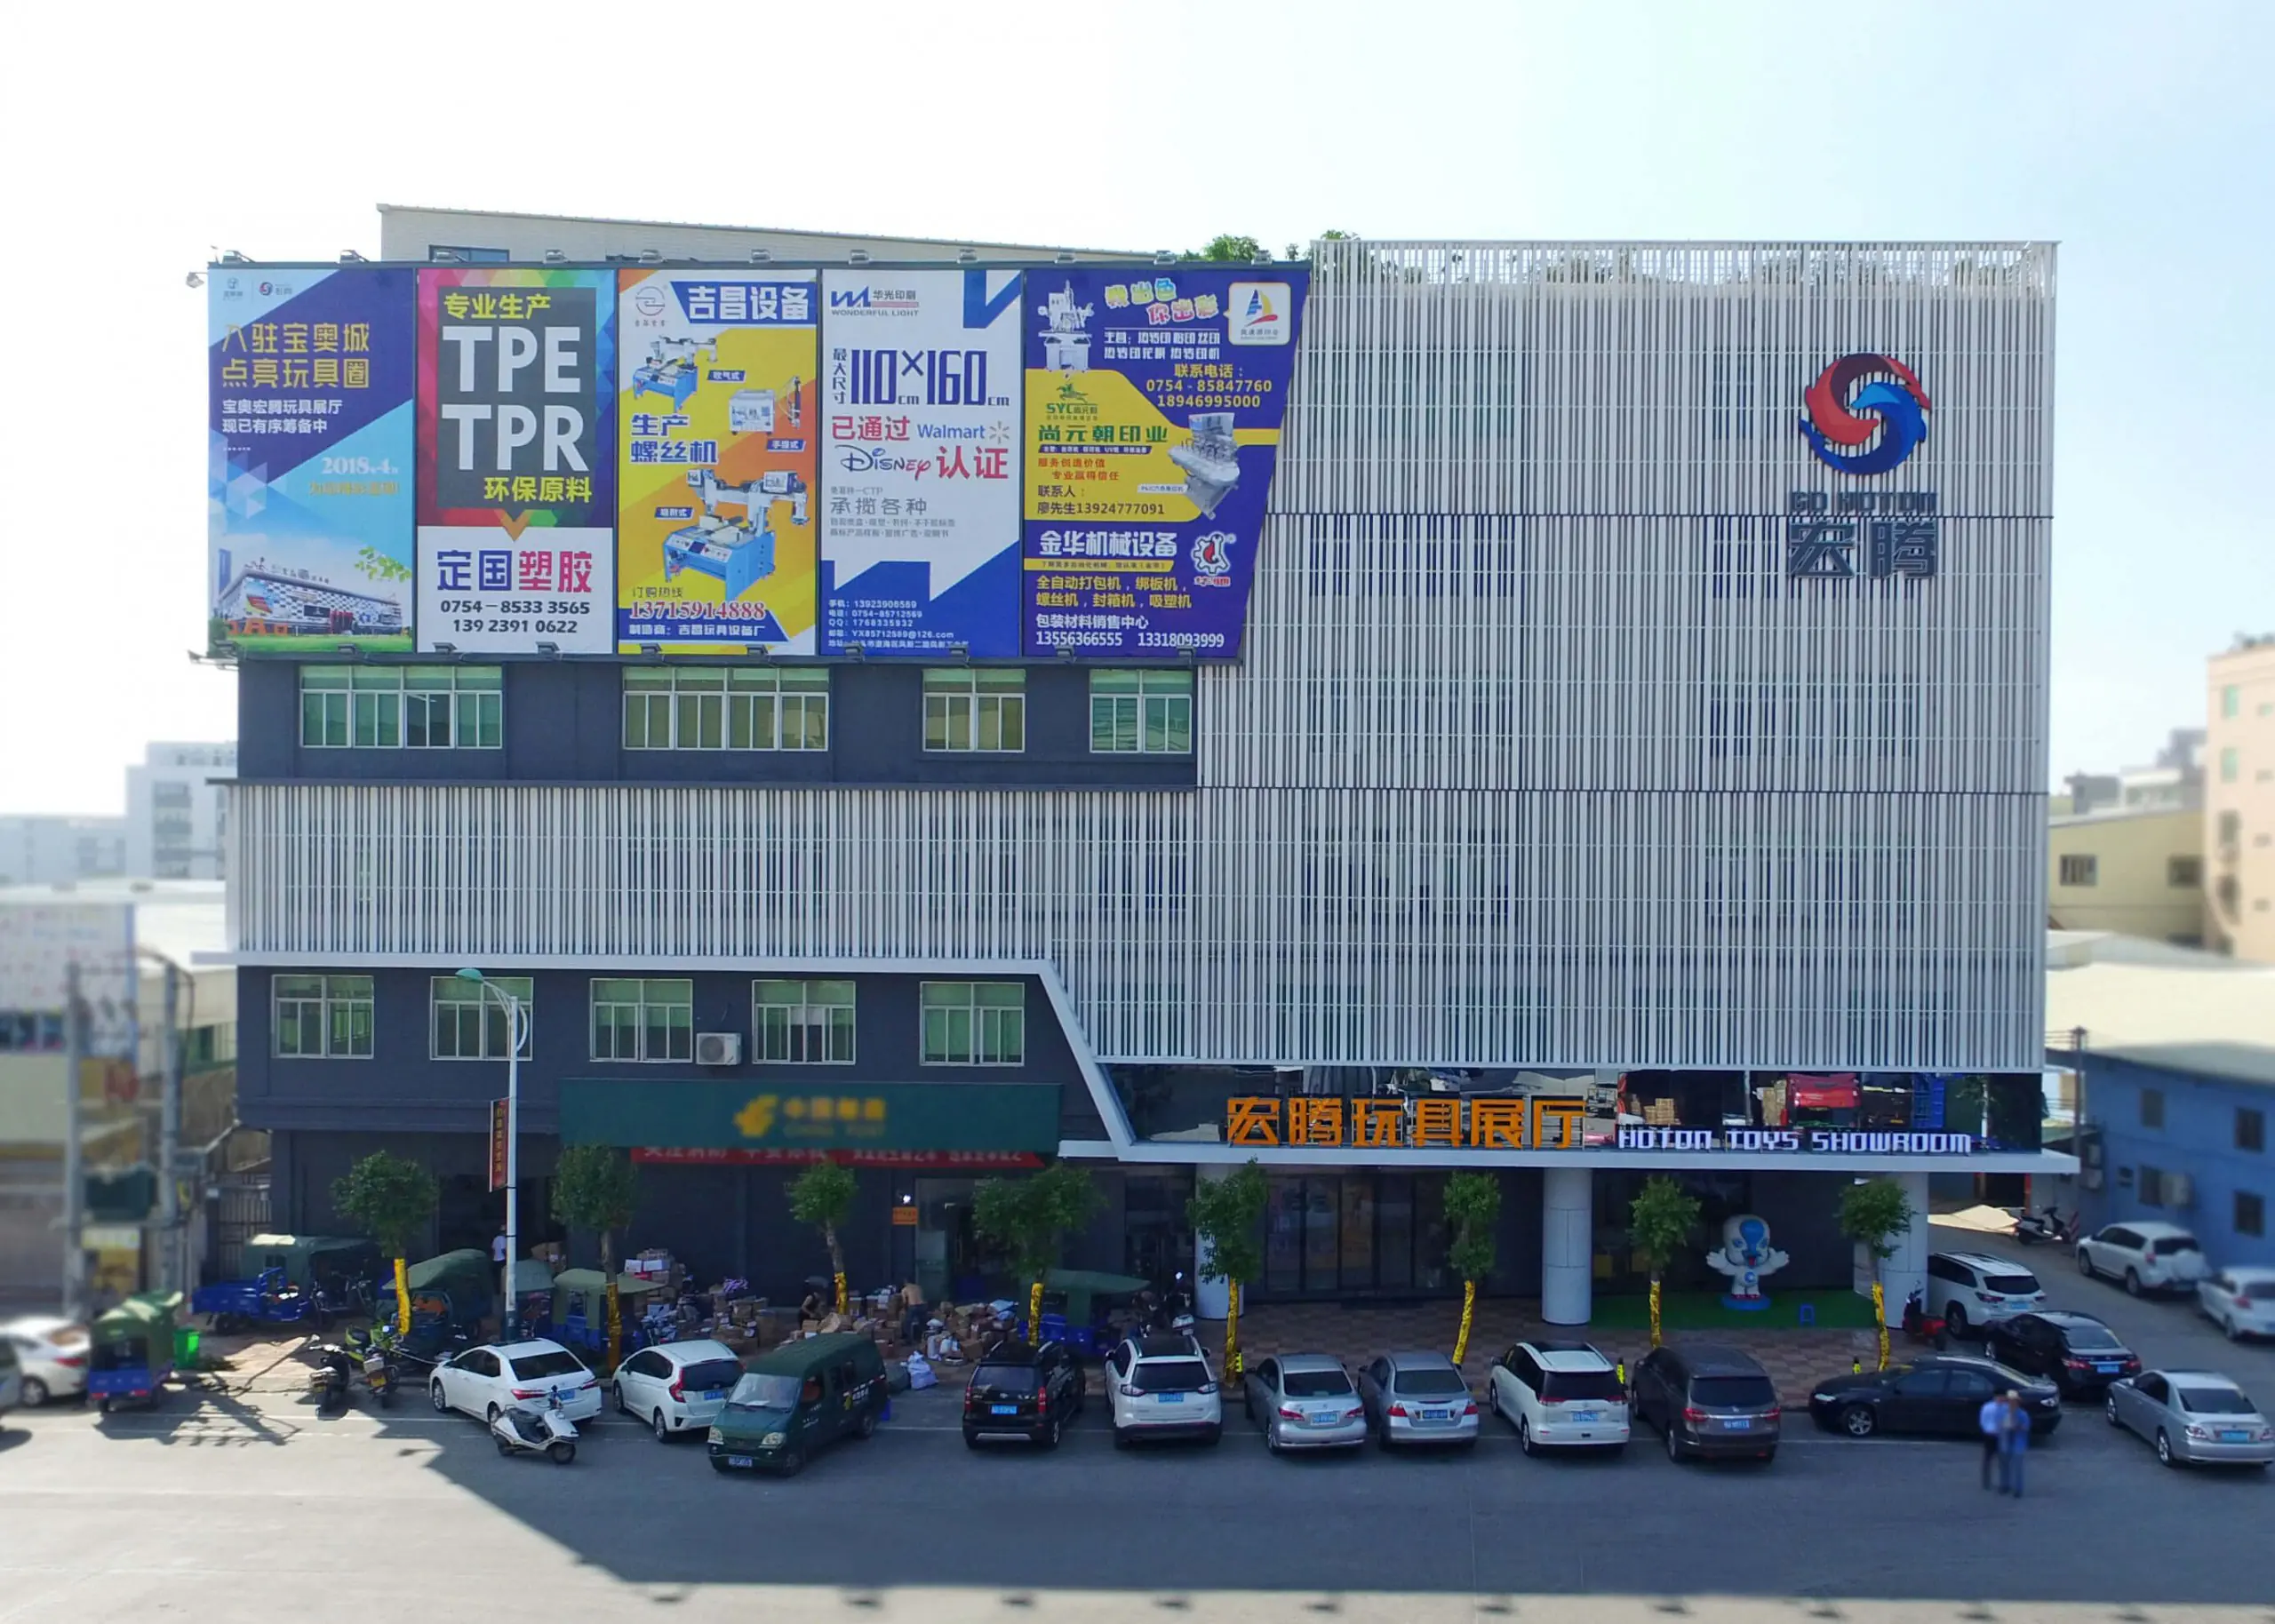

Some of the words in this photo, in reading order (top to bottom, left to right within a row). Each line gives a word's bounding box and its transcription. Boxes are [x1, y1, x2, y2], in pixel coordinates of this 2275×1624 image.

[443, 293, 551, 320] 专业生产
[688, 286, 808, 320] 吉昌设备
[873, 290, 916, 300] 华光印刷
[222, 322, 370, 353] 入驻宝奥城
[443, 326, 580, 393] TPE
[222, 358, 370, 388] 点亮玩具圈
[833, 347, 847, 404] 最大尺寸
[1146, 379, 1183, 392] 0754
[1197, 379, 1273, 393] 85847760
[222, 399, 343, 415] 宝奥宏腾玩具展厅
[1157, 394, 1261, 408] 18946995000
[222, 418, 327, 434] 现已有序筹备中
[442, 404, 589, 471] TPR
[631, 414, 690, 437] 生产
[832, 416, 910, 441] 已通过
[917, 424, 986, 439] Walmart
[1038, 425, 1168, 443] 尚元朝印业
[631, 441, 718, 464] 螺丝机
[936, 445, 1009, 480] 认证
[483, 476, 592, 503] 环保原料
[830, 498, 927, 516] 承揽各种
[1039, 530, 1177, 557] 金华机械设备
[437, 550, 592, 593] 定国塑胶
[547, 601, 590, 615] 3565
[630, 601, 766, 620] 13715914888
[453, 619, 483, 633] 139
[489, 620, 528, 633] 2391
[535, 620, 578, 633] 0622
[1036, 614, 1149, 630] 包装材料销售中心
[1036, 631, 1122, 647] 13556366555
[1138, 633, 1225, 648] 13318093999
[1227, 1096, 1586, 1150] 宏腾玩具展厅
[1618, 1128, 1712, 1150] HOTON
[1726, 1130, 1799, 1151] TOYS
[1812, 1132, 1971, 1153] SHOWROOM
